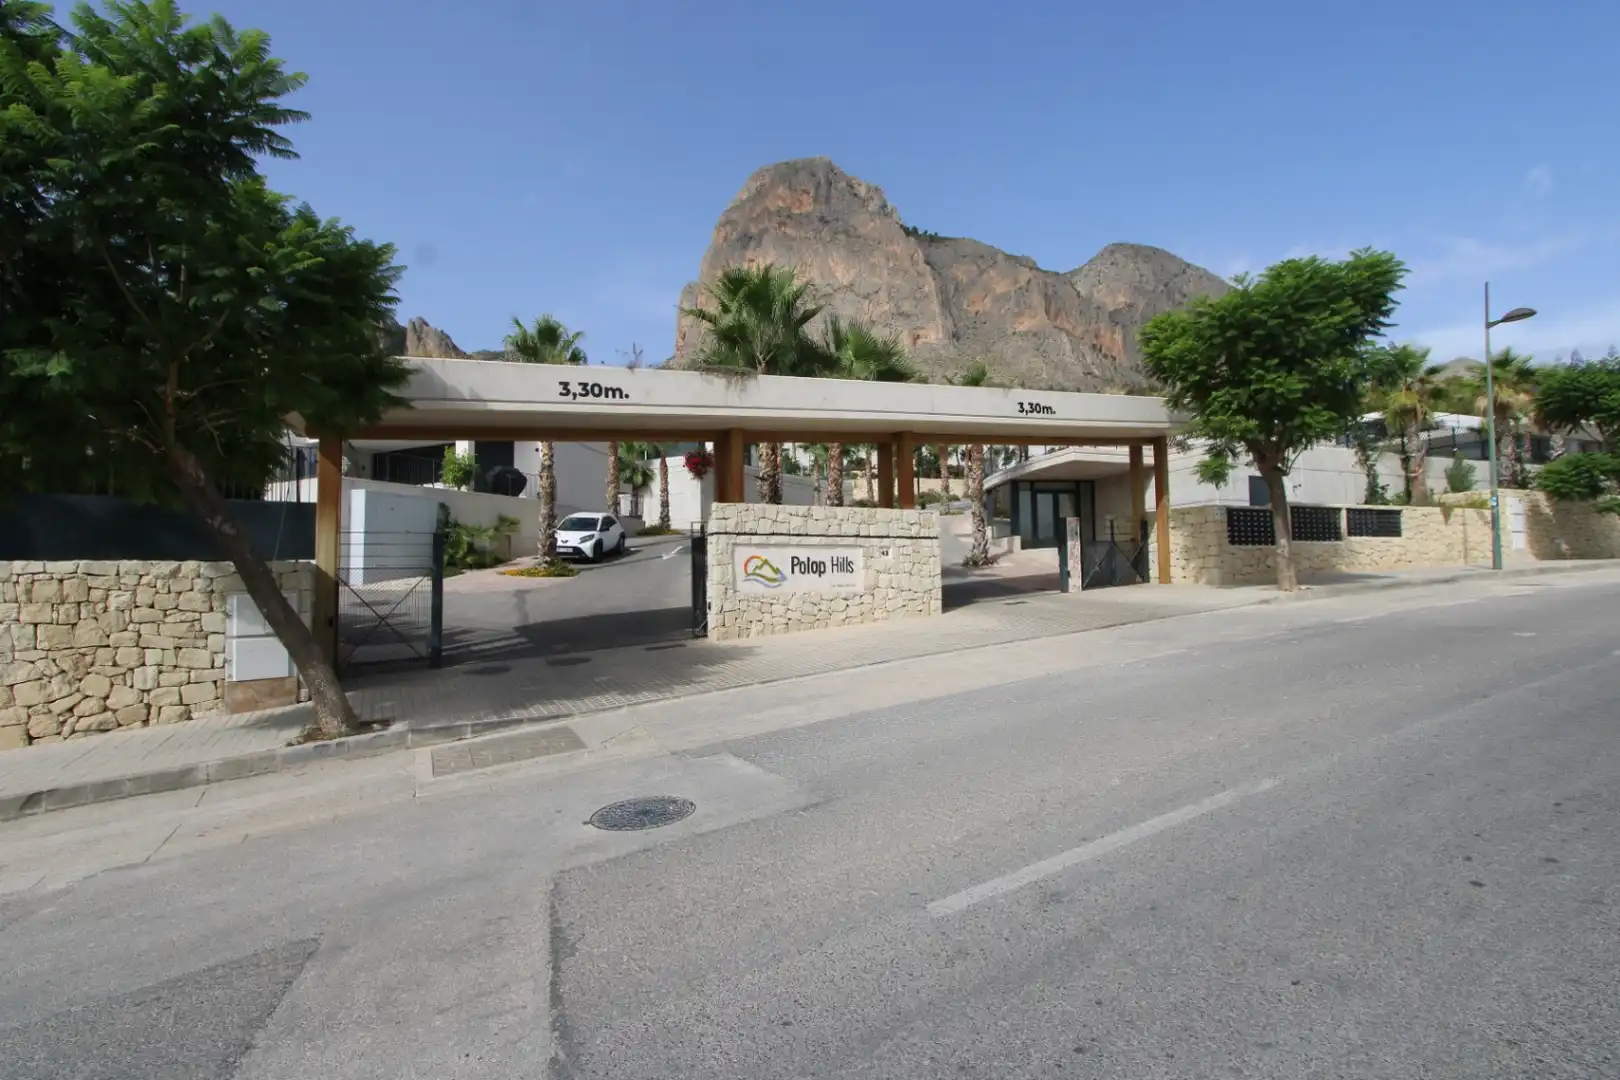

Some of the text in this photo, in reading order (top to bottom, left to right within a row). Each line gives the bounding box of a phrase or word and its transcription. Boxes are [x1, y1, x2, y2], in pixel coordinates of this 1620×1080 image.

[558, 381, 630, 401] 3,30m.
[1017, 401, 1056, 416] 3,30m.
[790, 555, 855, 578] Polop Hills
